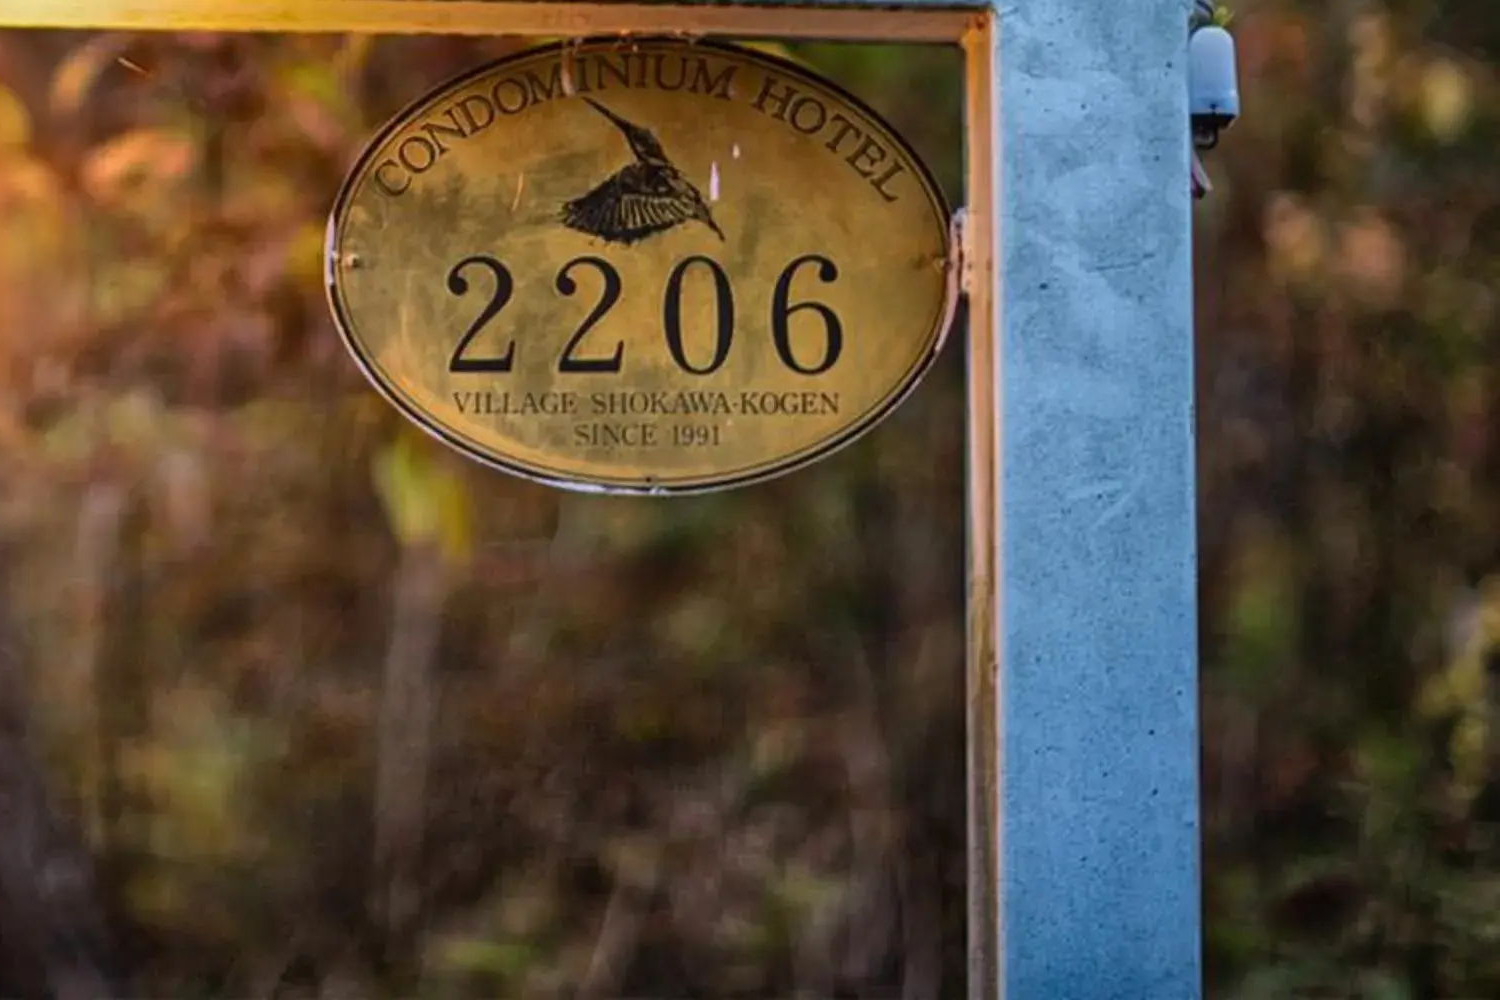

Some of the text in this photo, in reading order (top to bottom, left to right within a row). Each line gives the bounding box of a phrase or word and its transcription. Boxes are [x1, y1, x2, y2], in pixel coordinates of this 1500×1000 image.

[371, 53, 911, 203] CONDOMINIUM HOTEL
[446, 254, 843, 376] 2206
[452, 391, 578, 415] VILLAGE
[573, 423, 721, 447] SINCE 1991
